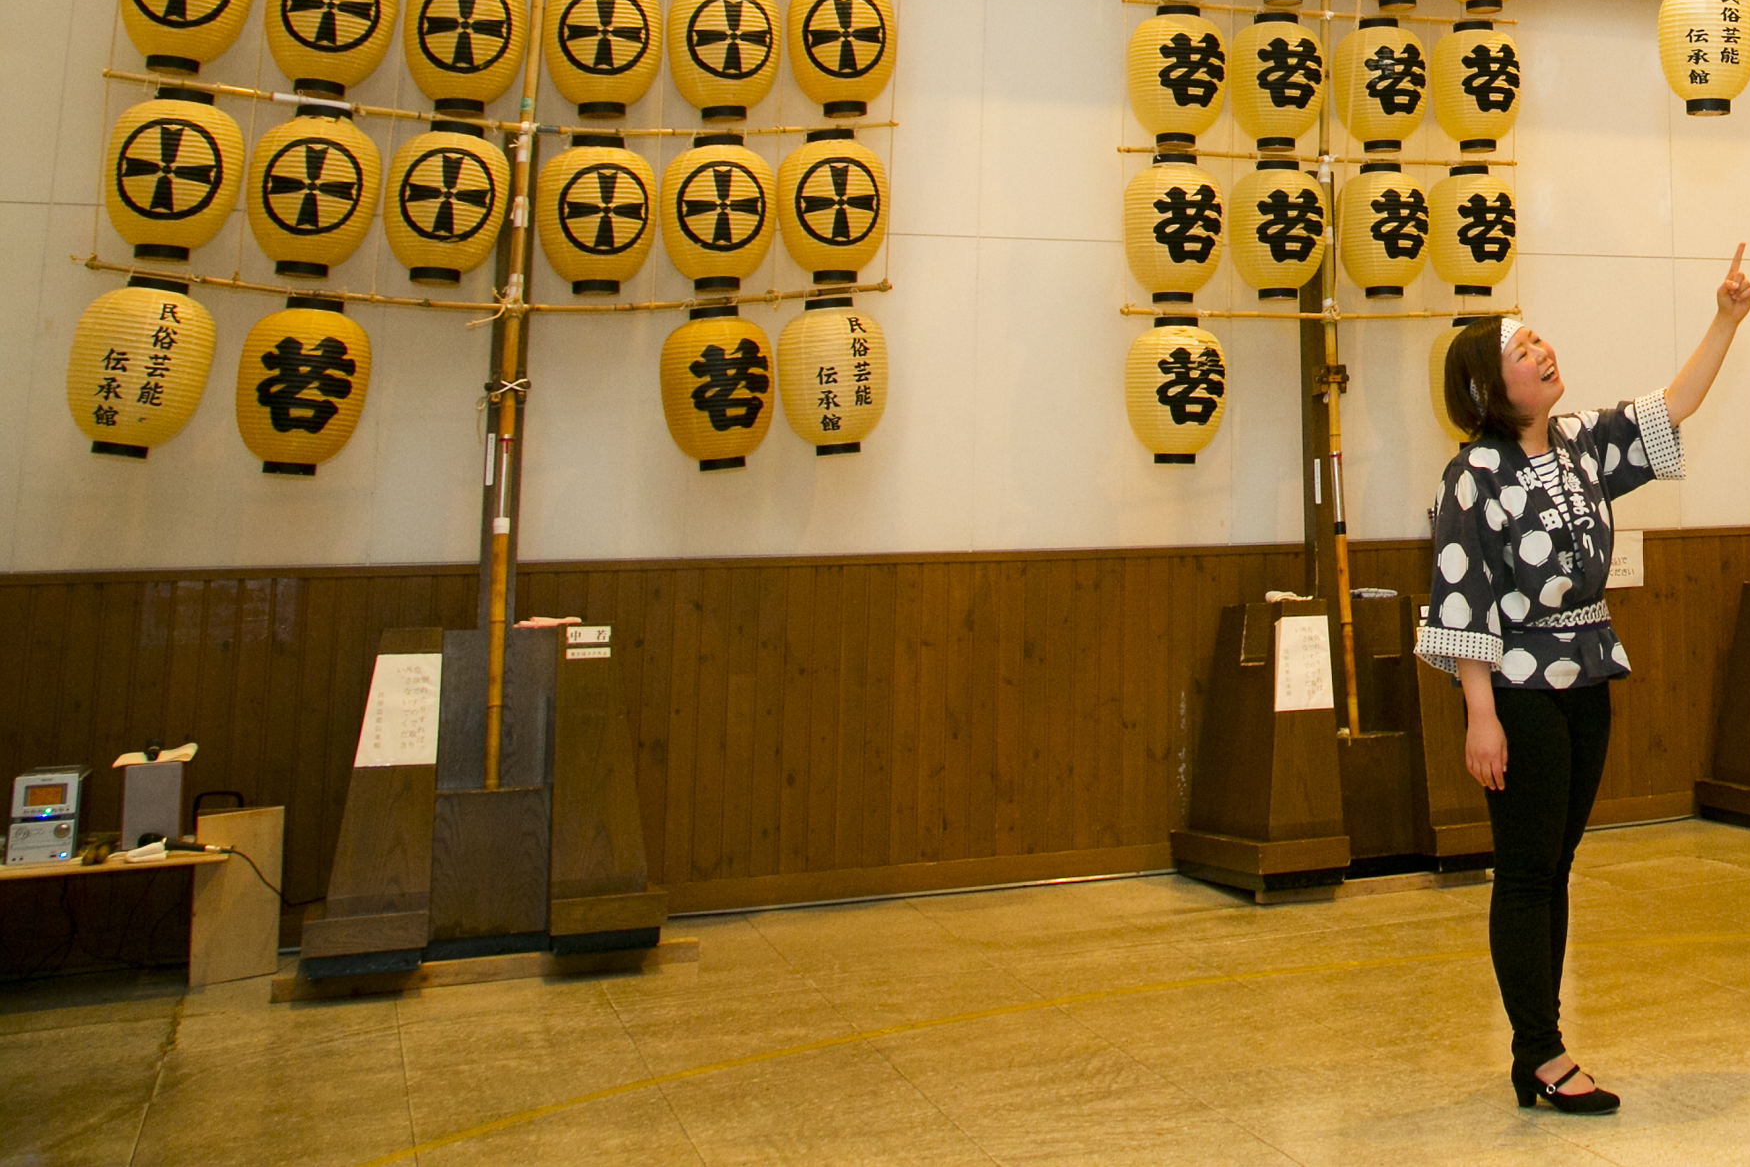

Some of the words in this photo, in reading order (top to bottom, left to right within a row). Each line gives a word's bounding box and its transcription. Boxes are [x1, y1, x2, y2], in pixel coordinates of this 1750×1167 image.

[1159, 33, 1225, 107] 若
[1257, 38, 1322, 109] 若
[1365, 44, 1425, 115] 若
[1462, 44, 1519, 112] 若
[1686, 29, 1709, 84] 伝承館
[1153, 185, 1221, 263] 若
[1256, 189, 1323, 263] 若
[1371, 189, 1428, 259] 若
[1457, 193, 1515, 262] 若
[92, 349, 129, 427] 伝承館
[137, 305, 179, 406] 民俗芸能
[255, 337, 355, 434] 若
[689, 339, 769, 432] 若
[849, 319, 872, 405] 民俗芸能
[1156, 348, 1225, 425] 若
[817, 367, 841, 431] 伝承館
